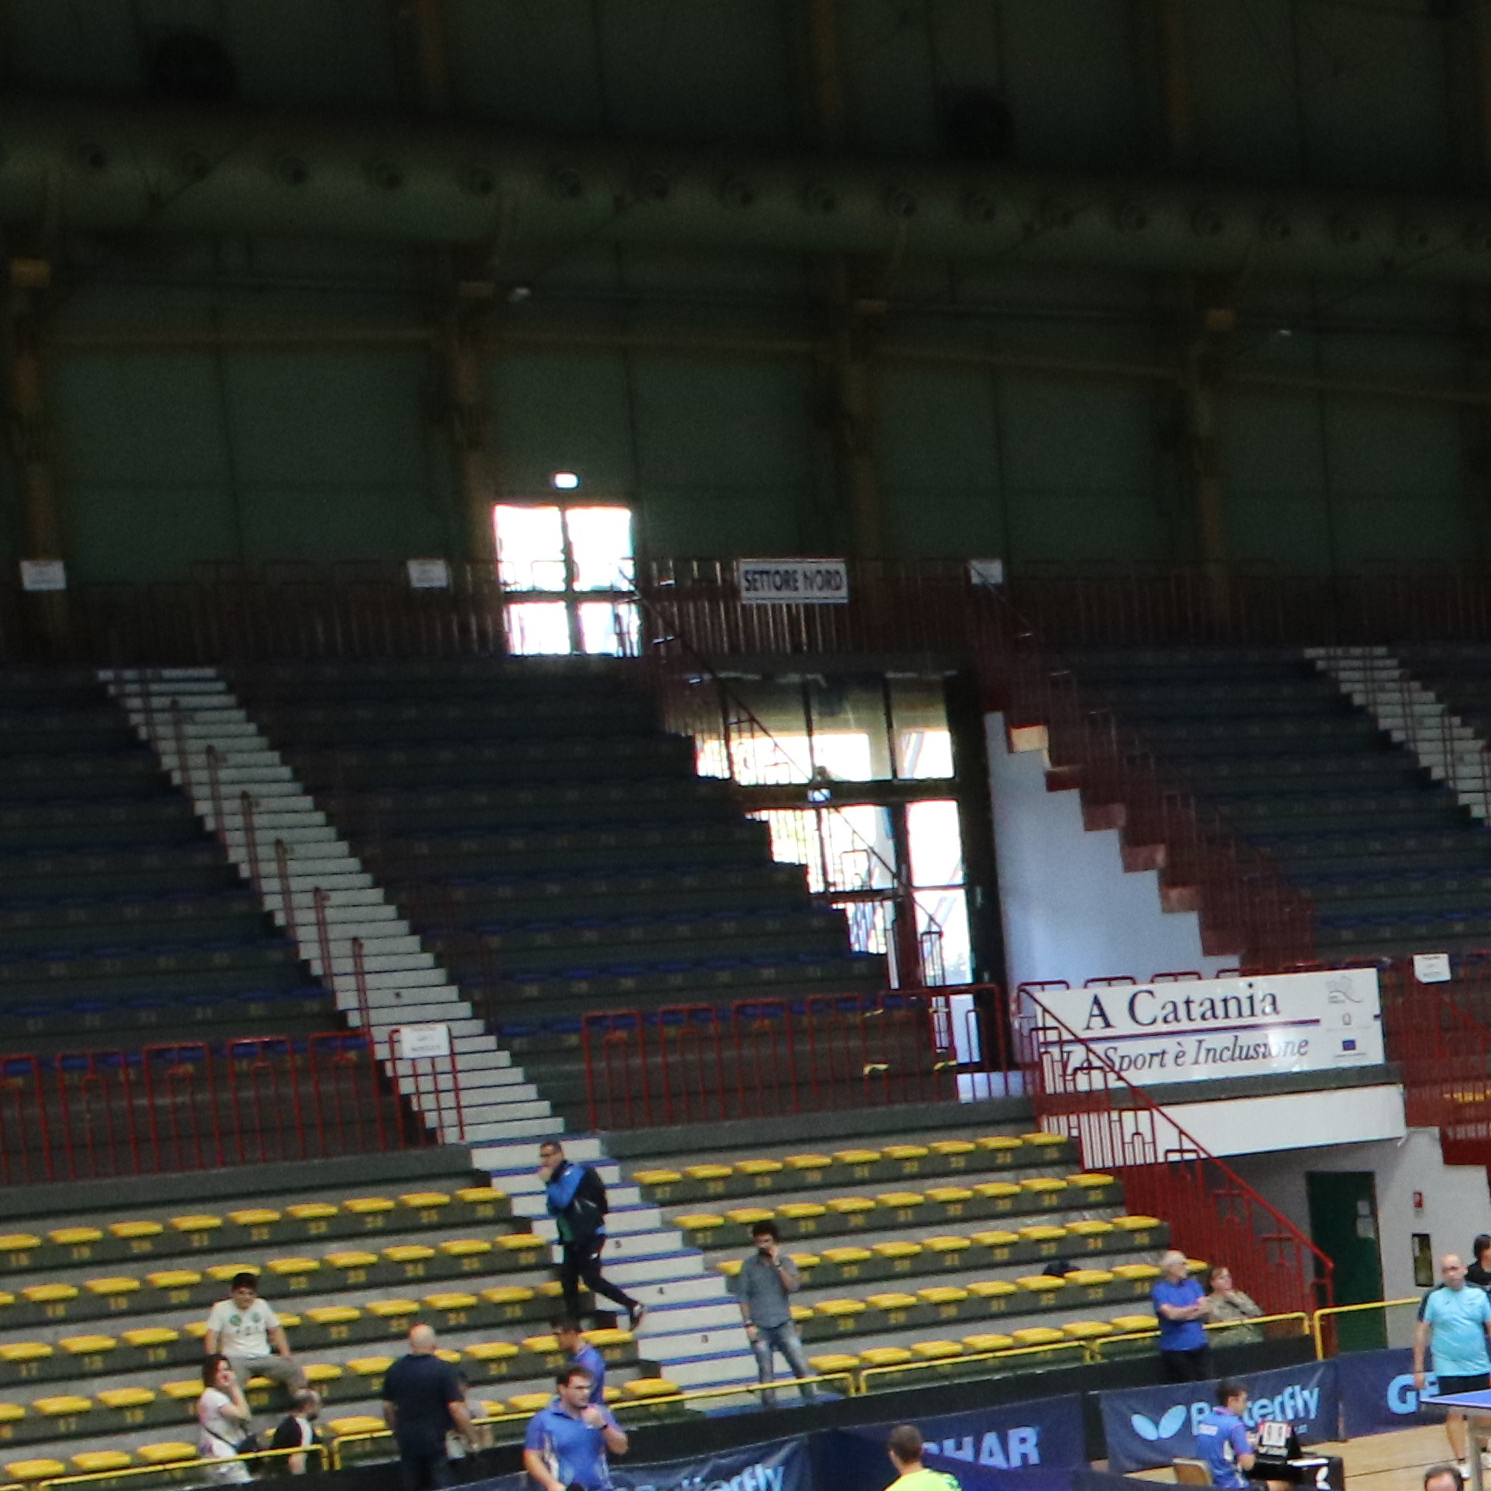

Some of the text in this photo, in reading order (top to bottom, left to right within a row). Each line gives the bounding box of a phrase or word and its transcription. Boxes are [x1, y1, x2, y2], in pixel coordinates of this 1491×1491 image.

[744, 569, 843, 592] SETTORE NORD
[1081, 992, 1117, 1031] A
[1127, 981, 1281, 1027] Catania
[1103, 1046, 1167, 1073] Sport
[1175, 1041, 1186, 1066] è
[1192, 1034, 1310, 1066] Inclusione
[1191, 1386, 1320, 1423] Bterfly
